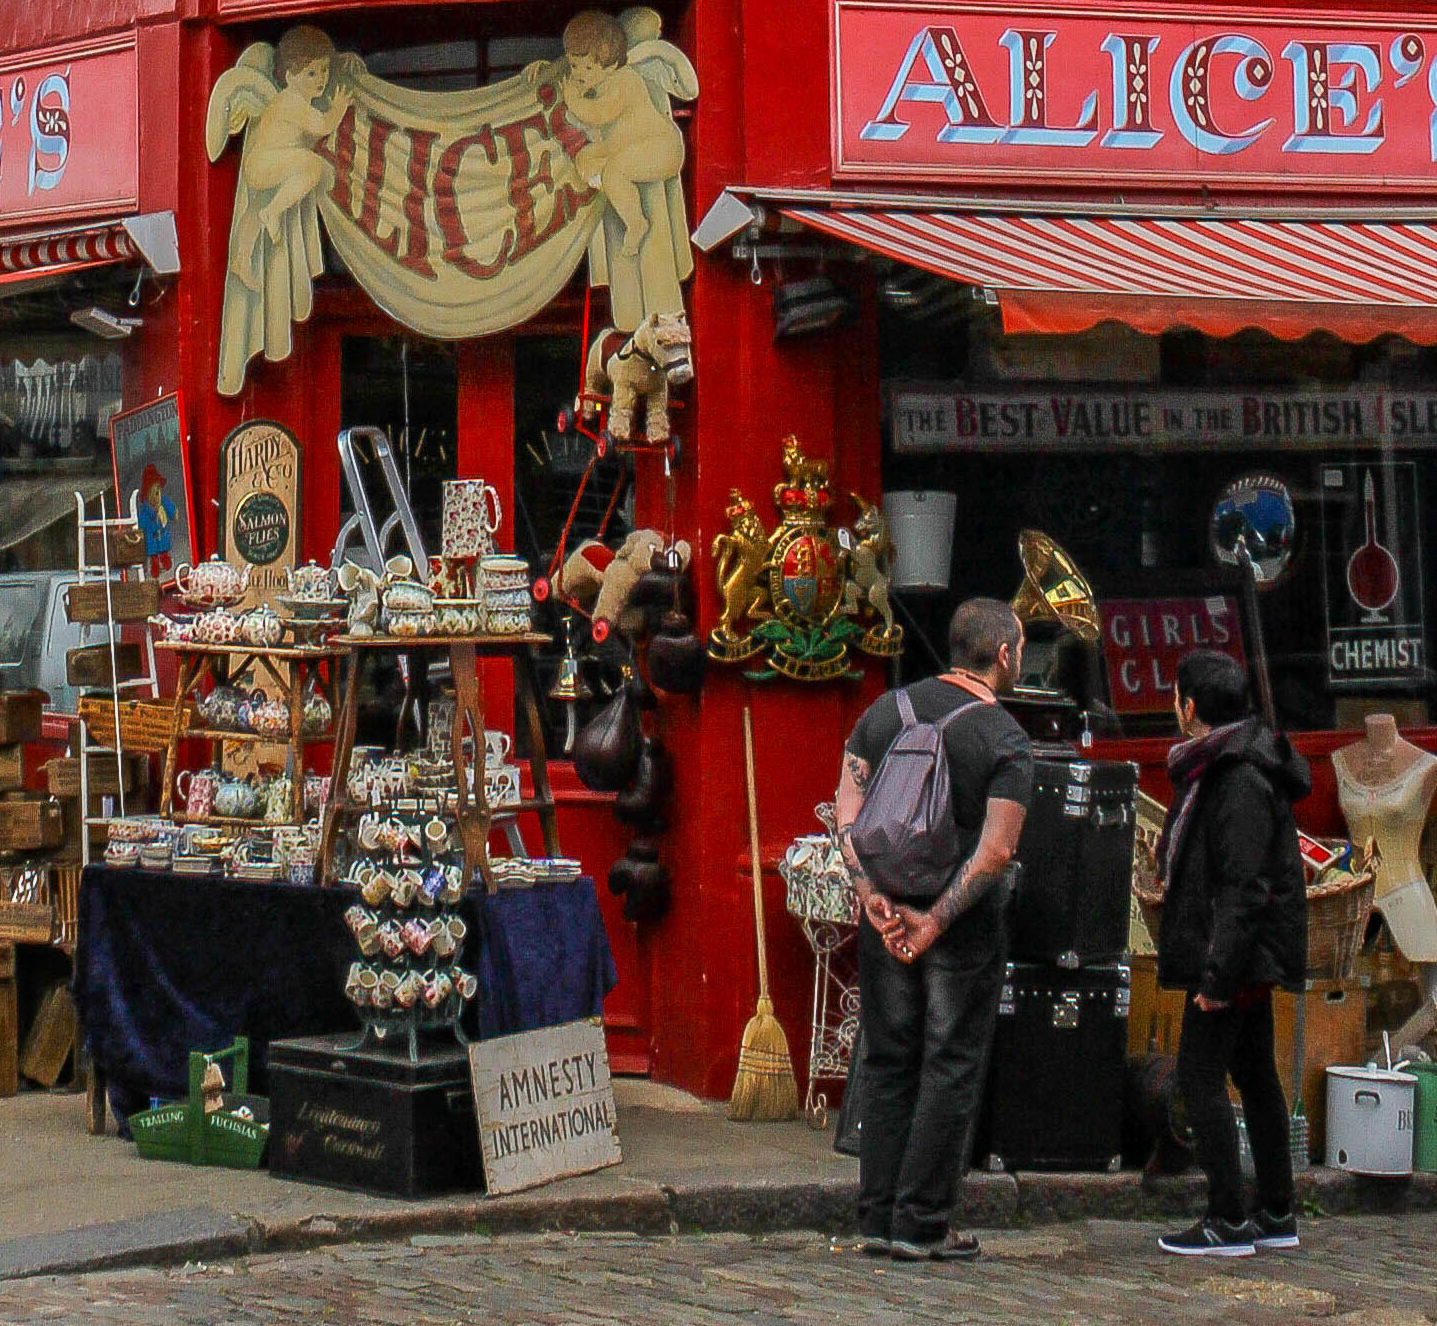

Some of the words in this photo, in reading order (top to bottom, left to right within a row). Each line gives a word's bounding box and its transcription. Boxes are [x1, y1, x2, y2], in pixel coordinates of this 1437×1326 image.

[859, 25, 1437, 161] ALICE'
[898, 409, 948, 432] THE
[955, 398, 1038, 437] BEST
[1050, 397, 1151, 438] VALUE
[1163, 408, 1184, 430] IN
[1195, 407, 1233, 431] THE
[1242, 396, 1363, 436] BRITISH
[230, 433, 282, 480] HARDY
[237, 512, 287, 532] SALMON
[245, 526, 280, 546] FLIES
[1110, 613, 1229, 648] GIRLS
[1330, 637, 1422, 671] CHEMIST
[1120, 658, 1173, 693] CL
[500, 1052, 596, 1111] AMNESTY
[139, 1110, 185, 1129] TRAILING
[210, 1114, 258, 1140] FUCHSIAS
[492, 1101, 613, 1159] INTERNATIONAL
